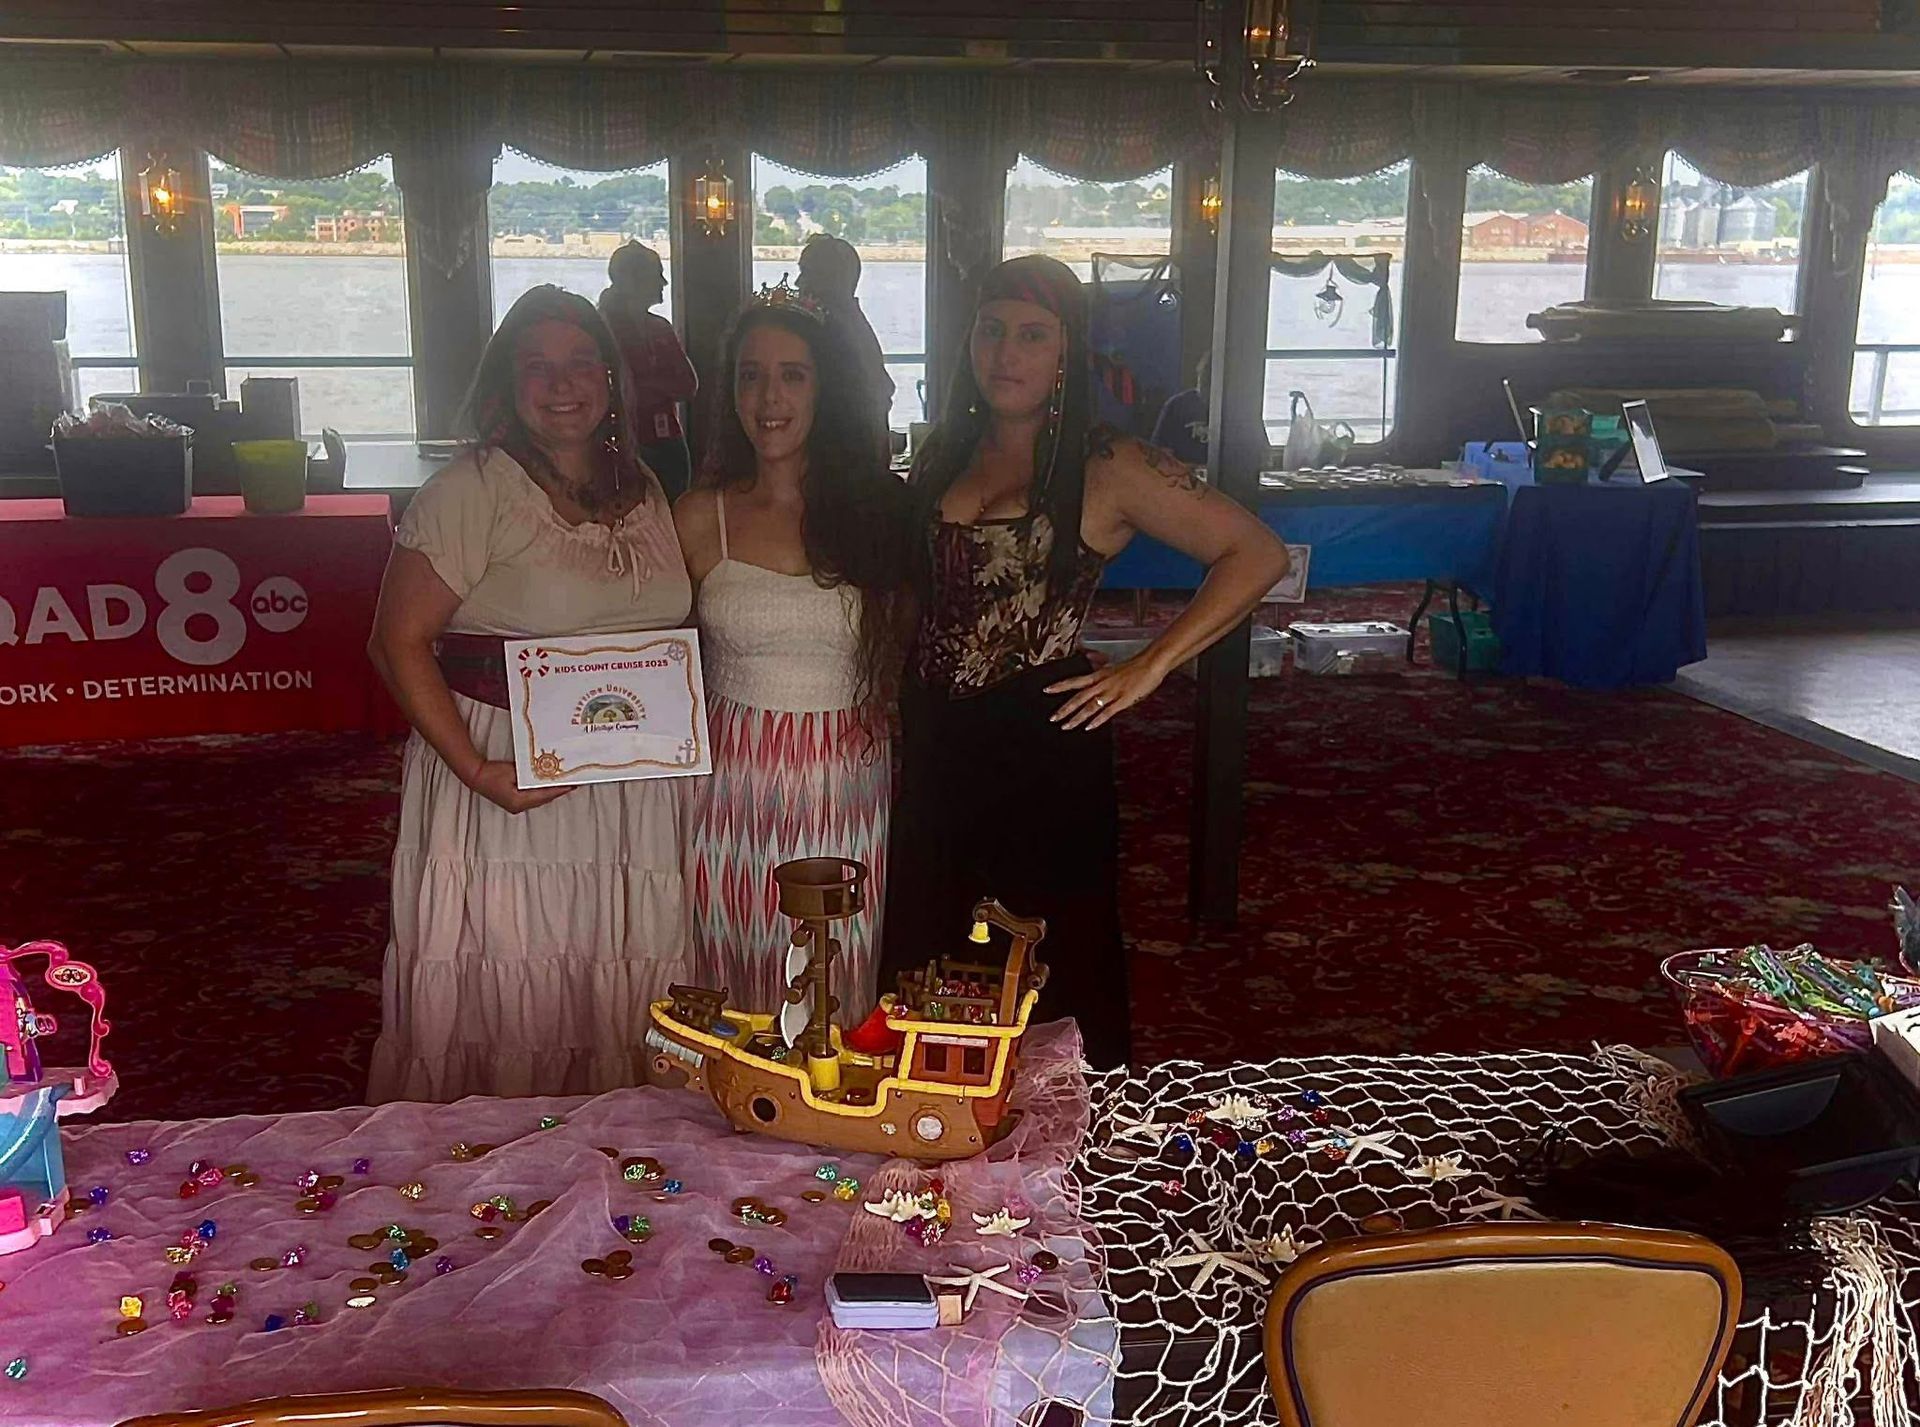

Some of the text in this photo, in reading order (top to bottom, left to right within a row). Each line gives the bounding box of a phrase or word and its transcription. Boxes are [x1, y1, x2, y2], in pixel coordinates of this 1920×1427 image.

[154, 547, 247, 665] 8
[251, 590, 308, 614] abc
[554, 659, 668, 674] KIDS COUNT CRUISE 2025
[83, 670, 313, 700] DETERMINATION
